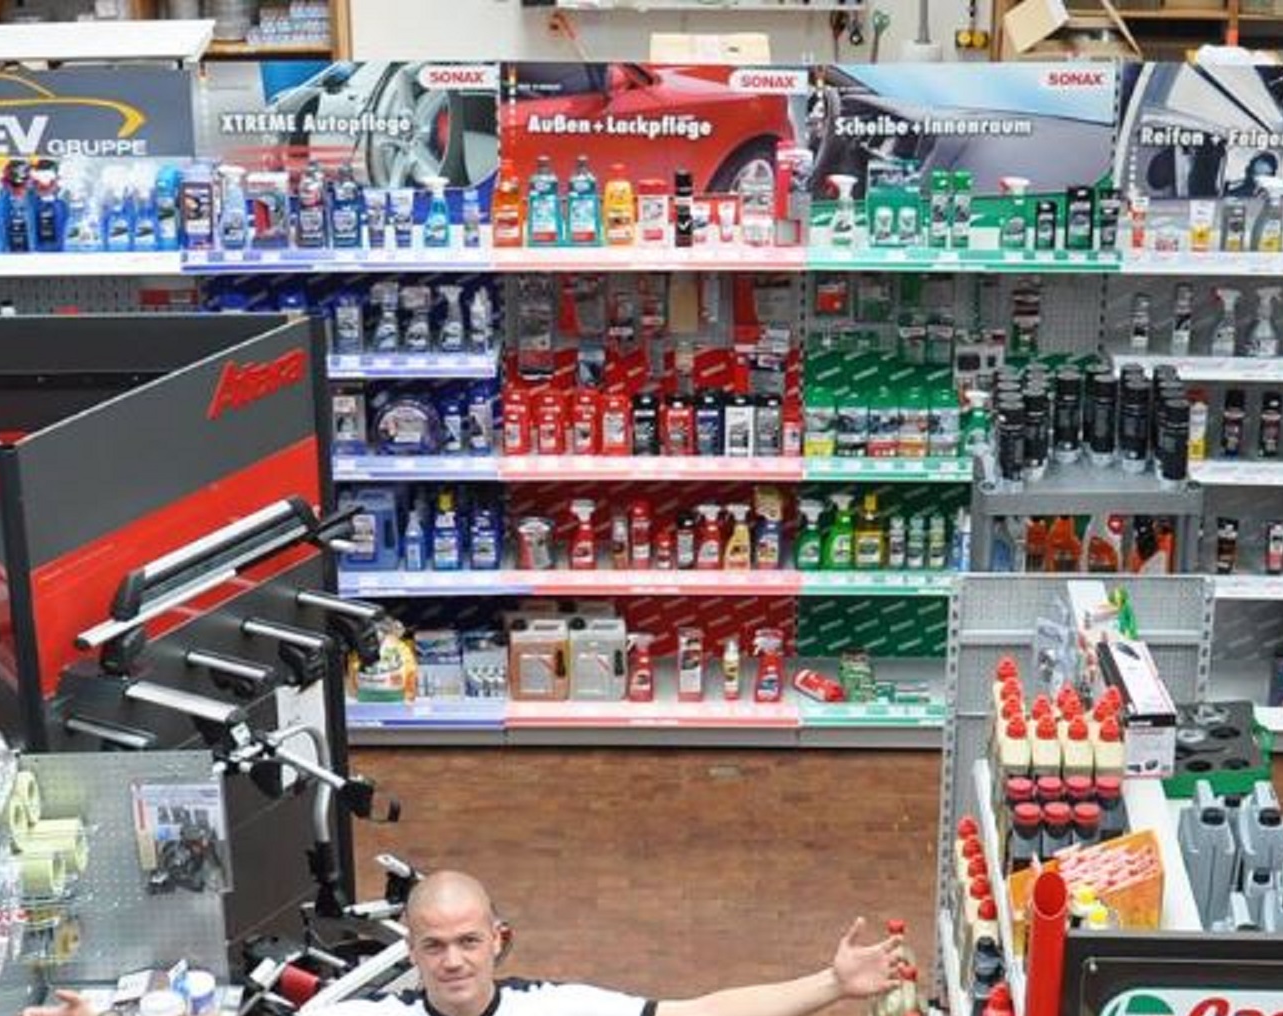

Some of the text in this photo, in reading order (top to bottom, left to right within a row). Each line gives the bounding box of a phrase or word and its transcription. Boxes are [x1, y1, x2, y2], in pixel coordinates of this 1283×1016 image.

[428, 71, 485, 84] SONAX
[738, 74, 797, 88] SONAX
[1047, 72, 1105, 87] SONAX
[221, 113, 412, 136] XTREME Autopflege
[1139, 126, 1205, 147] Reifen
[47, 139, 148, 156] GRUPPE
